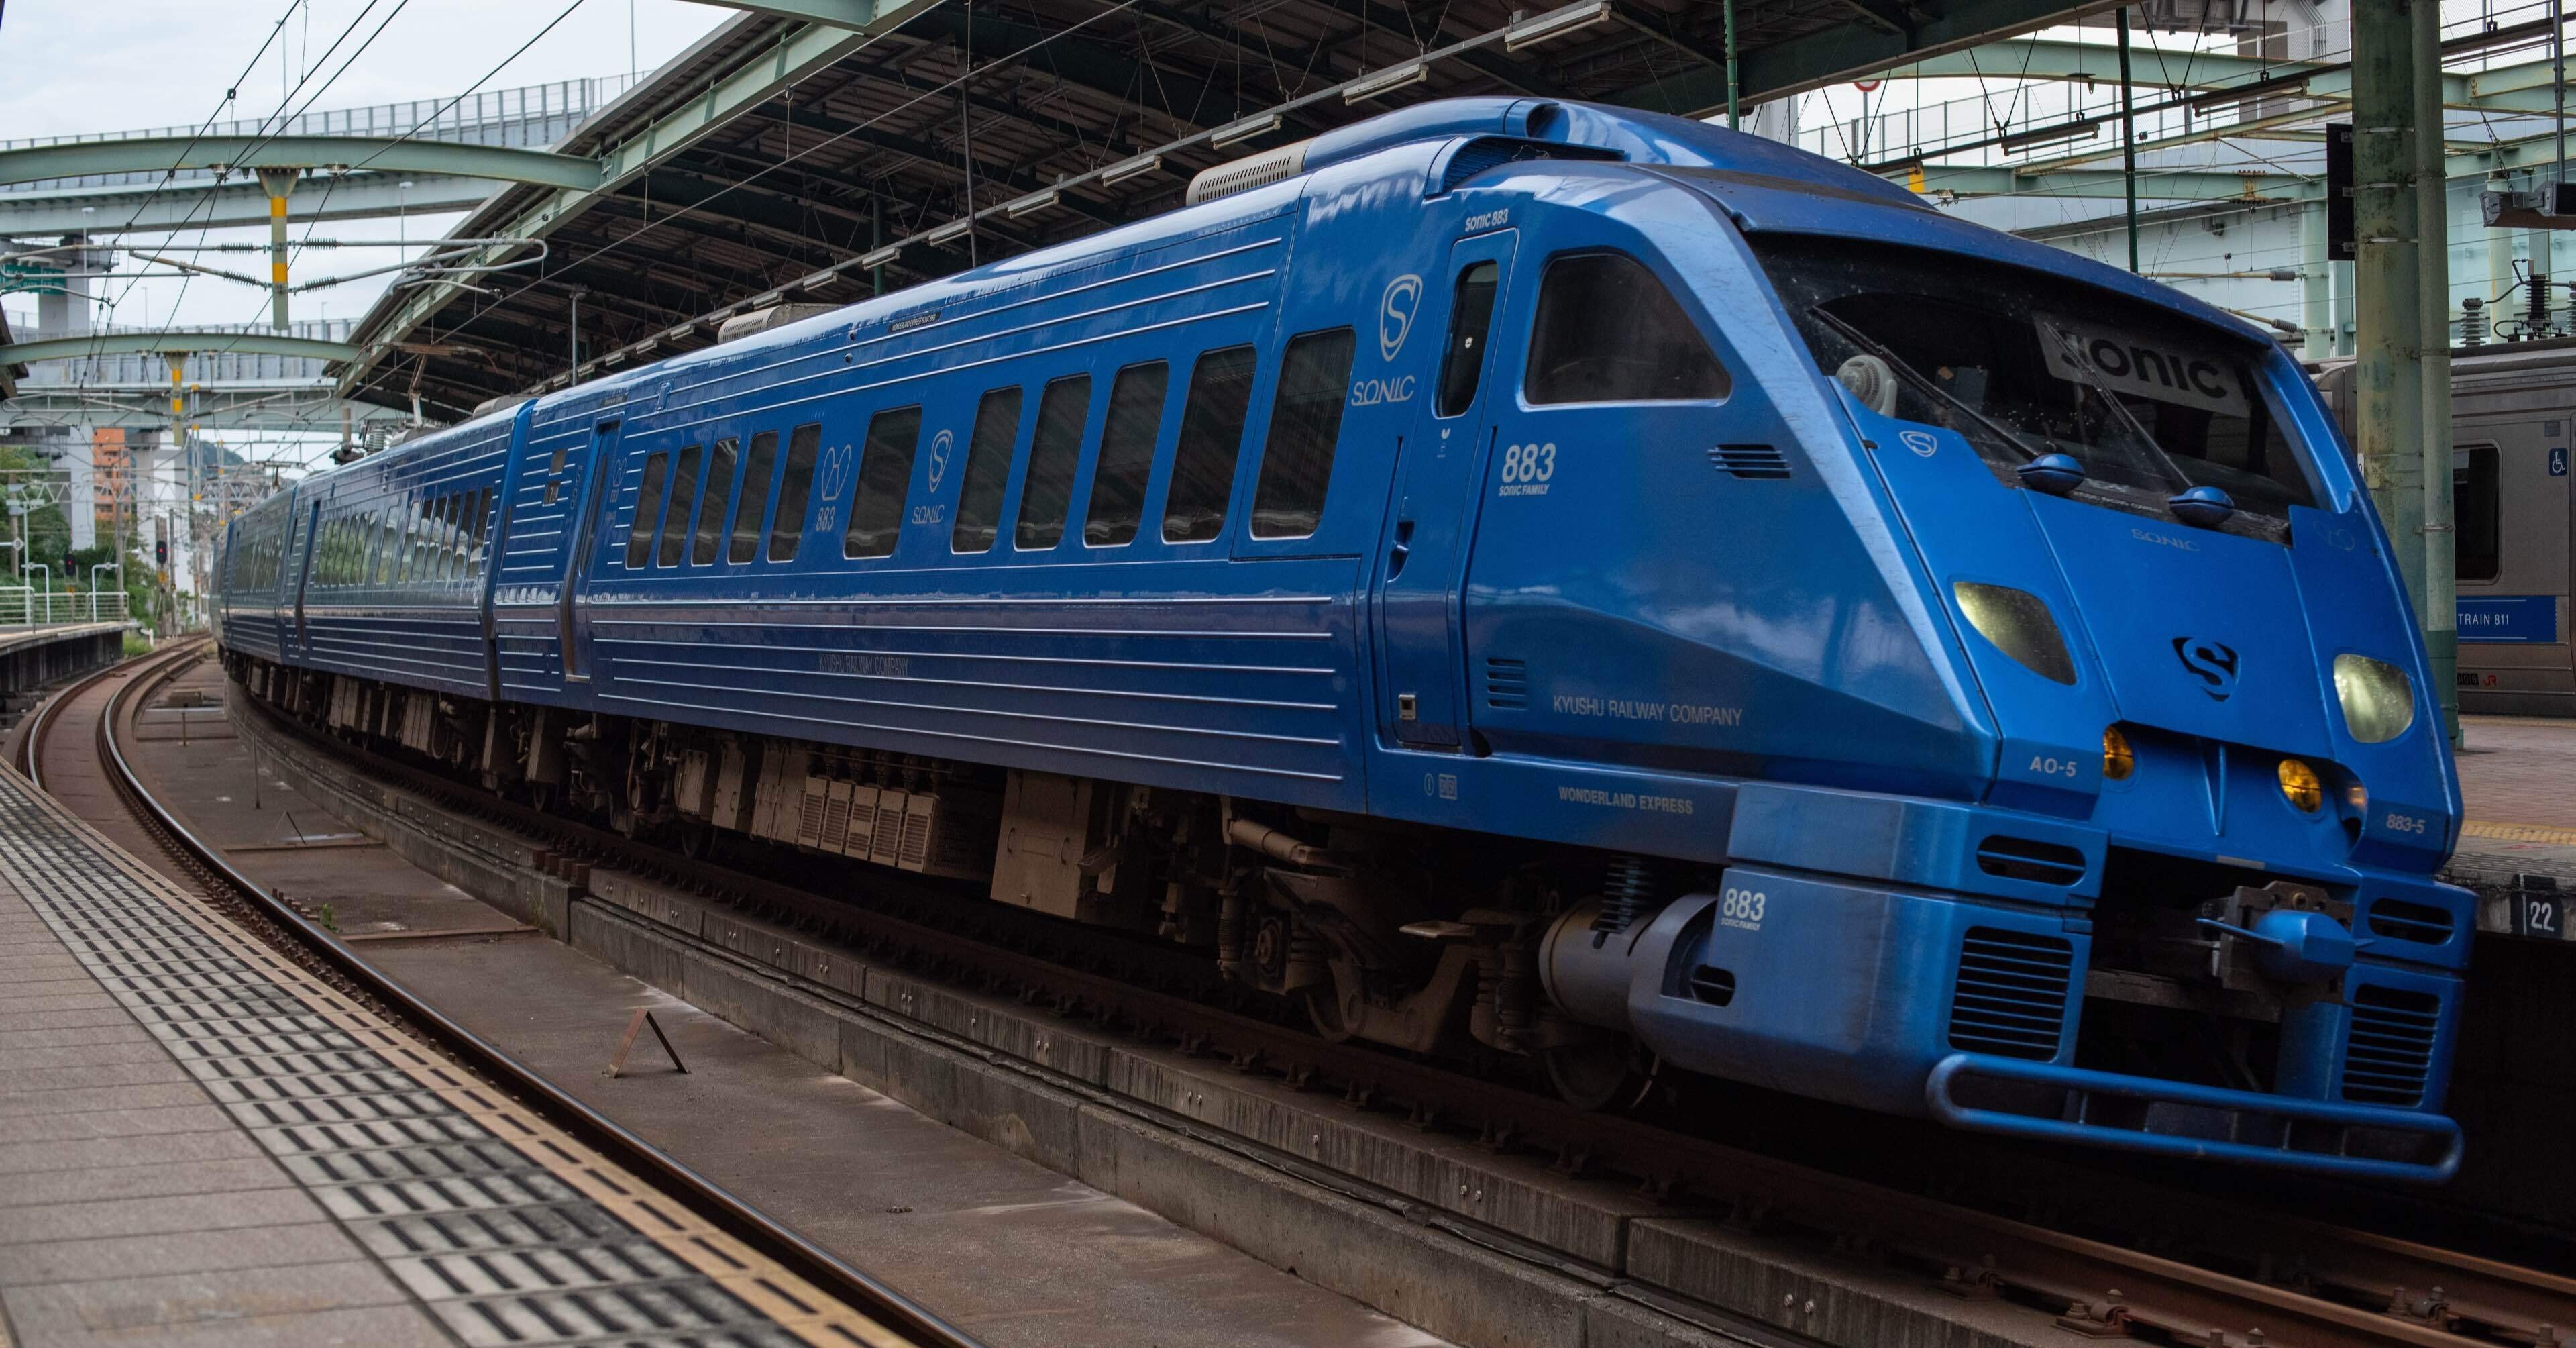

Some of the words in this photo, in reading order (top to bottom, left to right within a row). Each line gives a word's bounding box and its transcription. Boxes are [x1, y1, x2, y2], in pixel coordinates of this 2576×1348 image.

[1464, 213, 1491, 232] SONIC
[1491, 208, 1509, 227] 883
[1351, 376, 1415, 407] SONIC
[1502, 443, 1556, 483] 883
[1499, 484, 1522, 497] SONIC
[1521, 484, 1550, 495] FAMILY
[816, 505, 836, 532] 883
[912, 504, 945, 524] SONIC
[2131, 529, 2201, 552] SONIC
[2457, 613, 2491, 625] TRAIN
[2494, 613, 2509, 625] 811
[2484, 674, 2498, 687] JR
[1554, 695, 1605, 716] KYUSHU
[1609, 700, 1665, 721] RAILWAY
[1670, 705, 1743, 726] COMPANY
[1558, 786, 1636, 808] WONDERLAND
[1639, 795, 1693, 815] EXPRESS
[2386, 813, 2426, 834] 883-5
[1723, 888, 1766, 921] 883
[2530, 901, 2555, 932] 22
